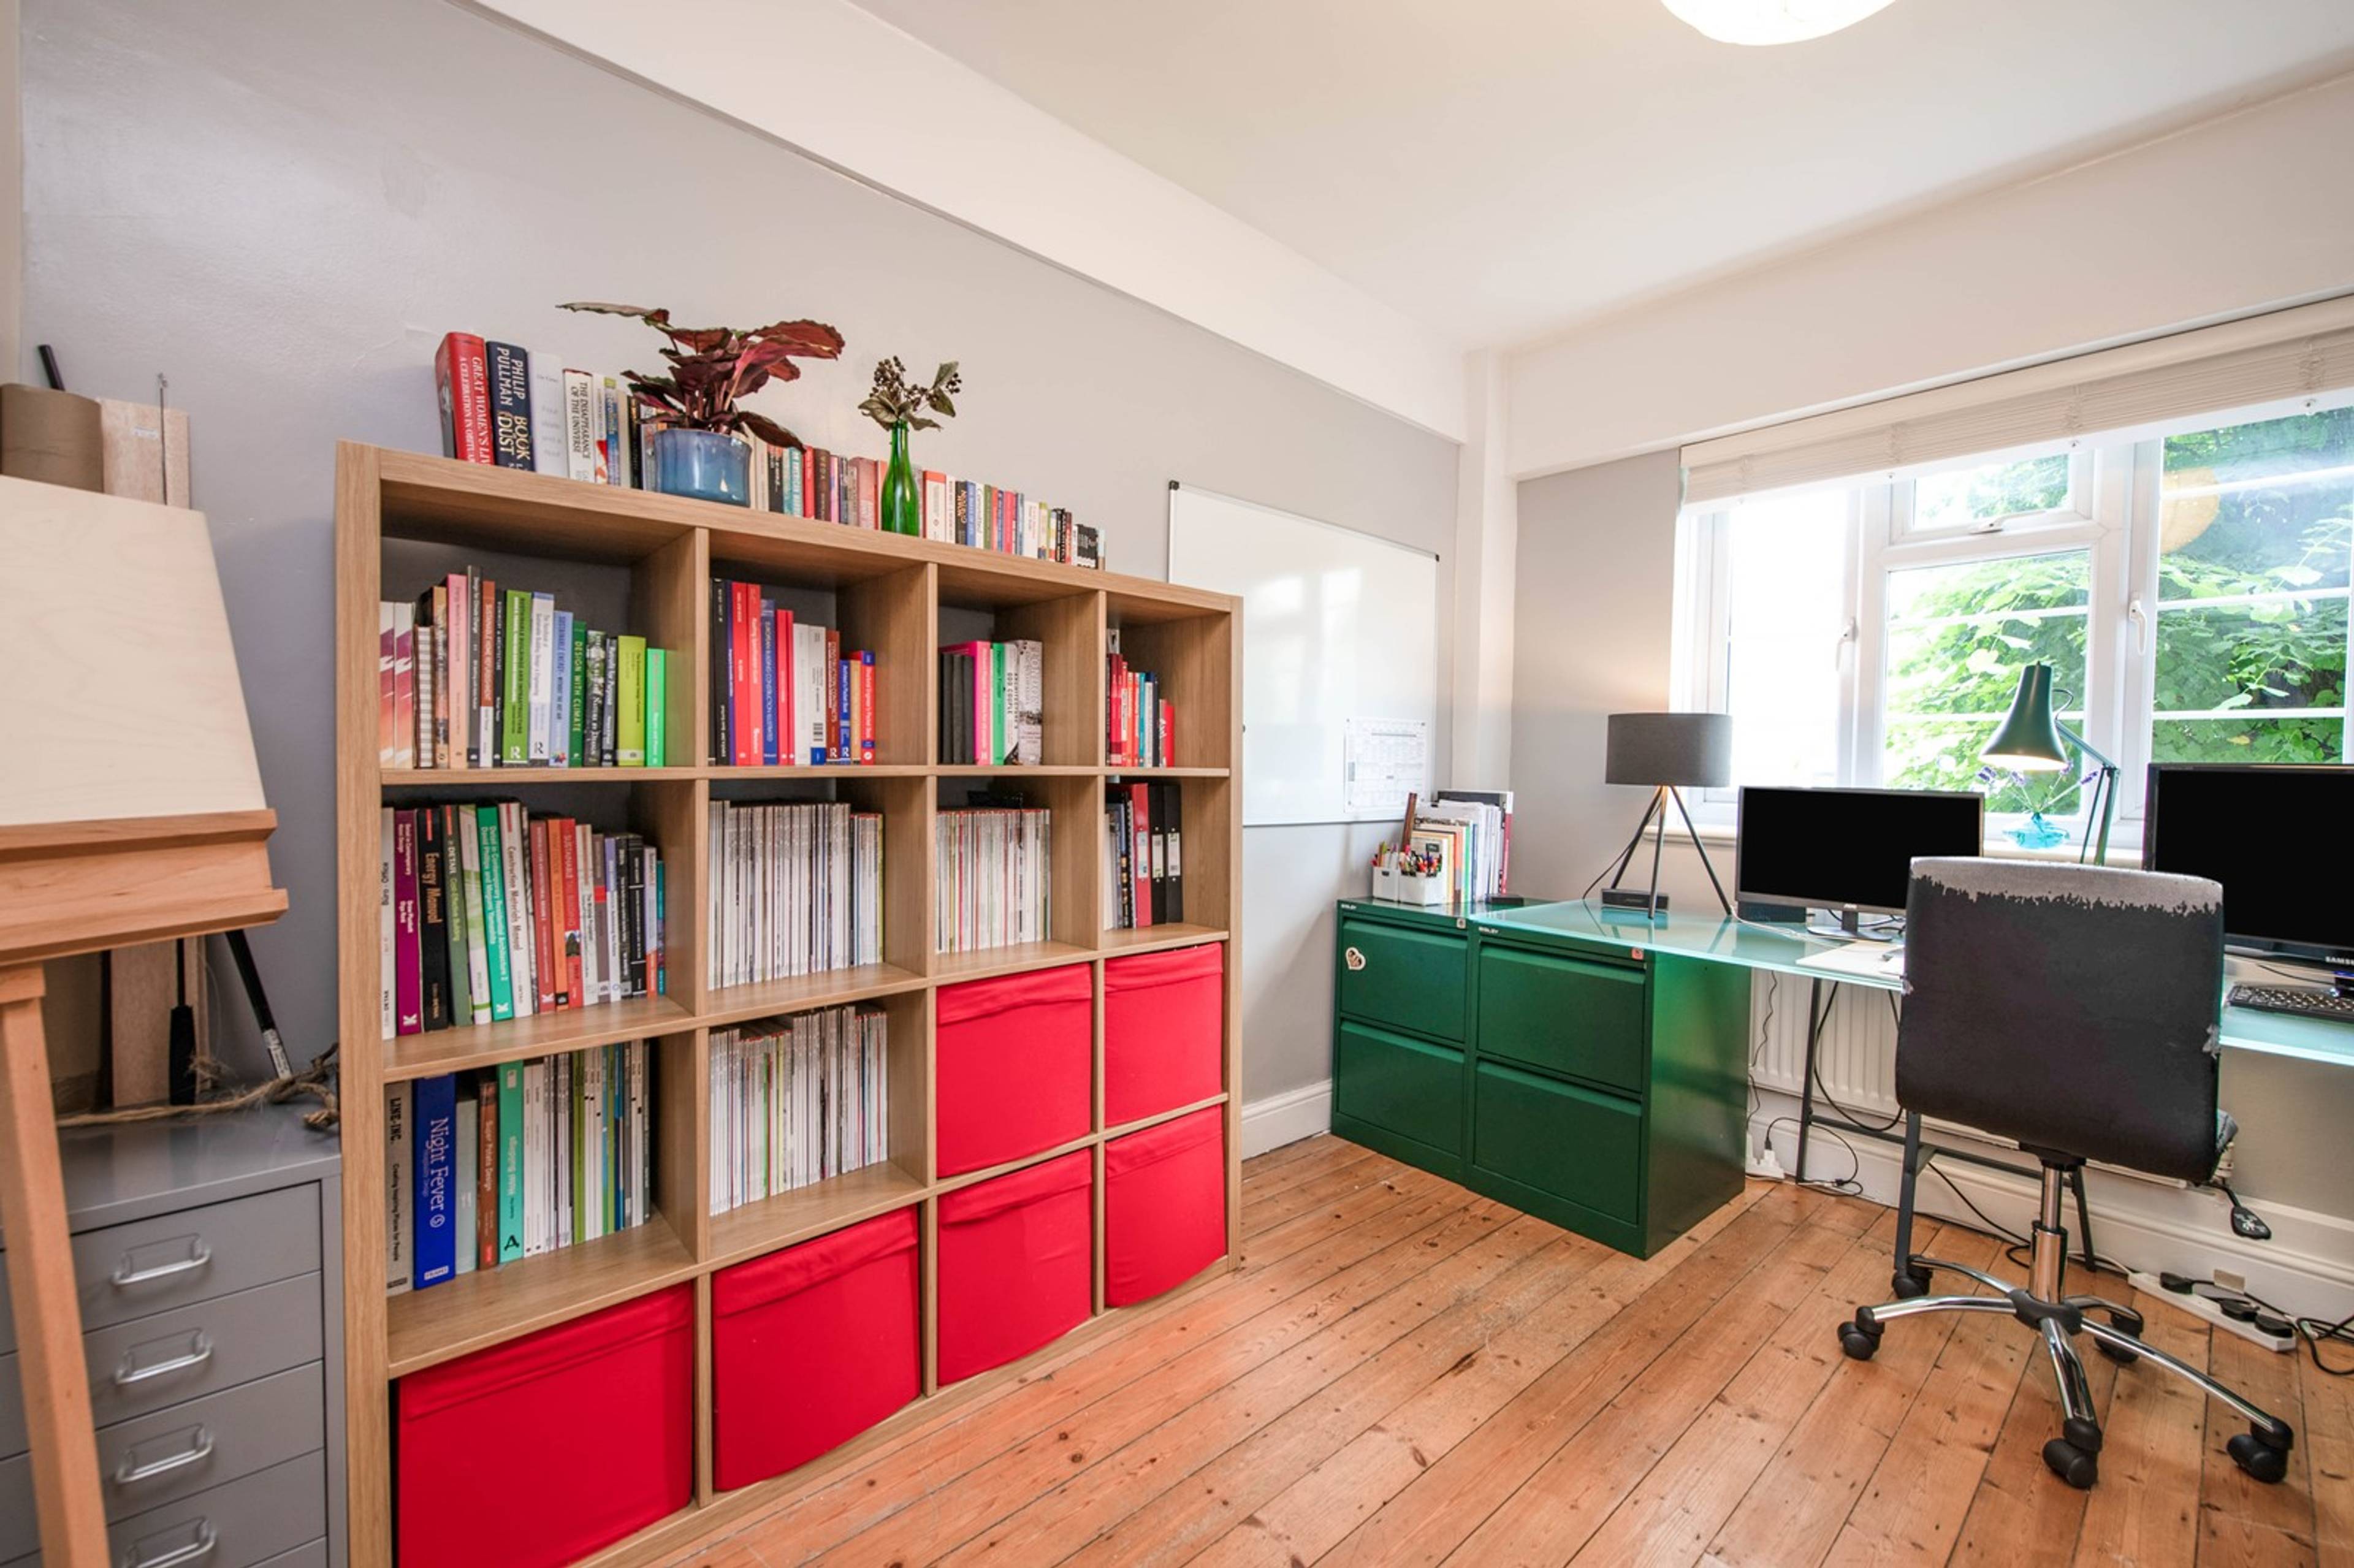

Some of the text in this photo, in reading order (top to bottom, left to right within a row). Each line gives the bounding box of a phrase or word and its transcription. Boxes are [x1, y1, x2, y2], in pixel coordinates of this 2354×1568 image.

[472, 357, 486, 394] GREAT
[497, 347, 513, 406] PULLMAN
[511, 359, 526, 400] PHILIP
[579, 382, 588, 398] THE
[476, 395, 490, 446] WOMEN'S
[497, 416, 515, 456] DUST
[514, 416, 531, 462] BOOK
[570, 386, 582, 454] OF THE UNIVERSE
[579, 398, 591, 459] DISAPPEARANCE
[558, 616, 566, 651] SUSTAINABLE
[608, 647, 616, 669] Retrofit
[573, 641, 583, 732] DESIGN WITH CLIMATE
[605, 681, 615, 706] Purpose
[448, 847, 457, 874] DETAIL
[491, 852, 500, 899] Contemporary
[563, 834, 574, 879] SUSTAINABLE
[421, 852, 444, 924] Energy Manual
[507, 845, 524, 951] Construction Materials Manual
[495, 900, 505, 935] Residential
[389, 1097, 402, 1144] LINE-INC.
[425, 1117, 449, 1164] Night
[391, 1163, 400, 1189] Creating
[482, 1121, 494, 1192] Super Potato Design
[392, 1189, 400, 1212] Inspiring
[430, 1166, 449, 1211] Fever
